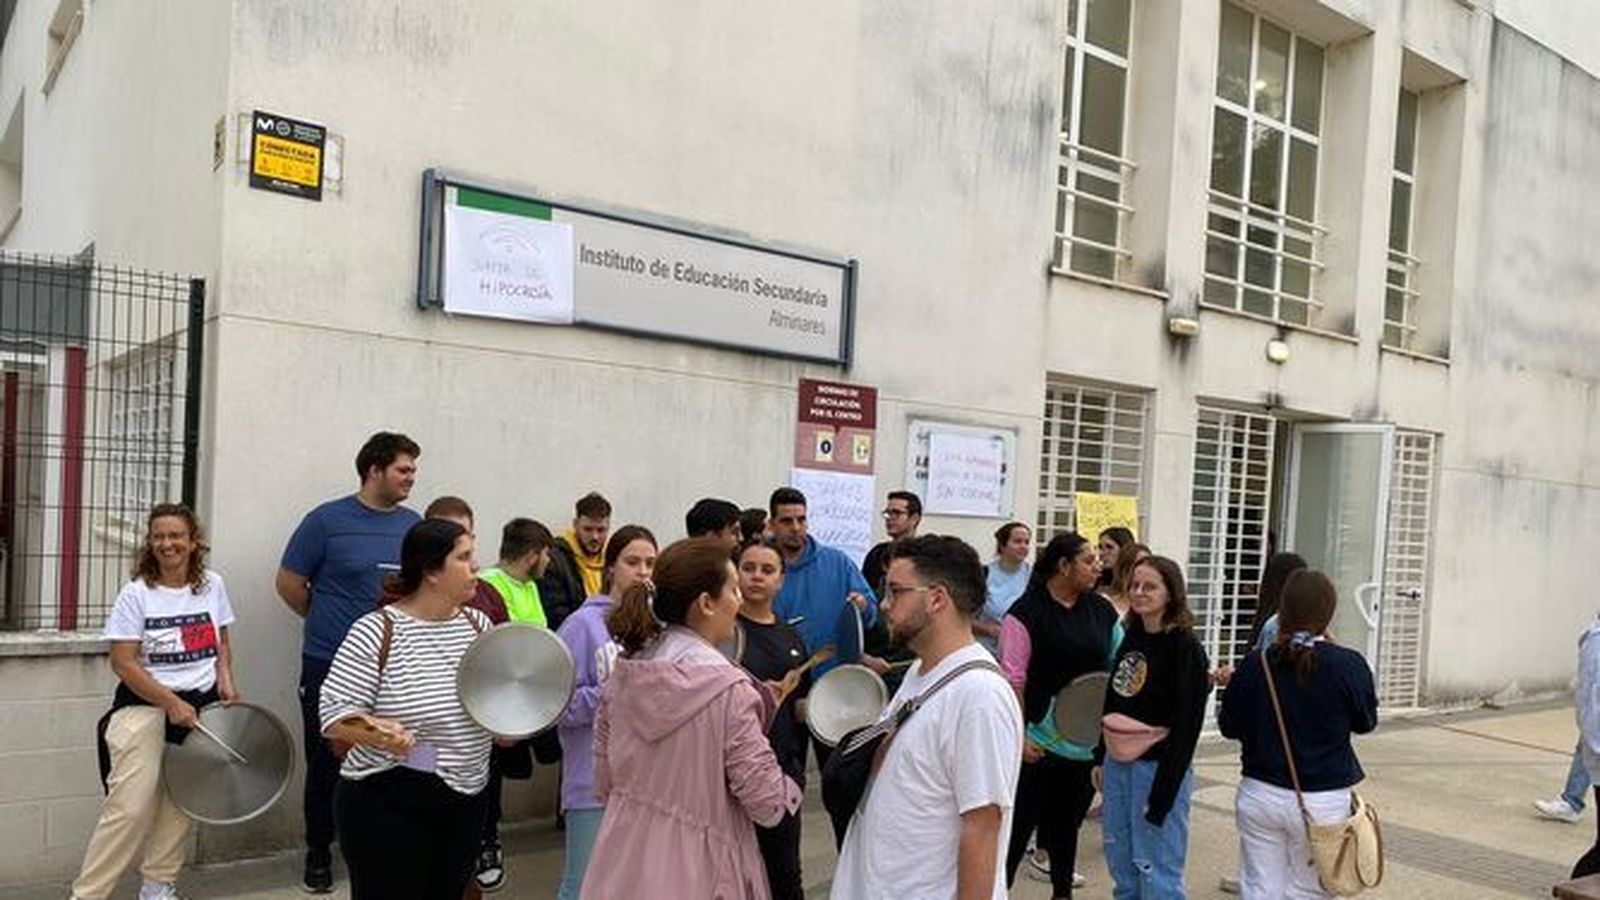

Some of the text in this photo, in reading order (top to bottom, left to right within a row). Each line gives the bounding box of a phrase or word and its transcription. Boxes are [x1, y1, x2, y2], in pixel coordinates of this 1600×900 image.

[579, 244, 828, 308] Instituto de Educación Secundaria
[768, 308, 827, 336] Alminares
[810, 408, 824, 418] POR
